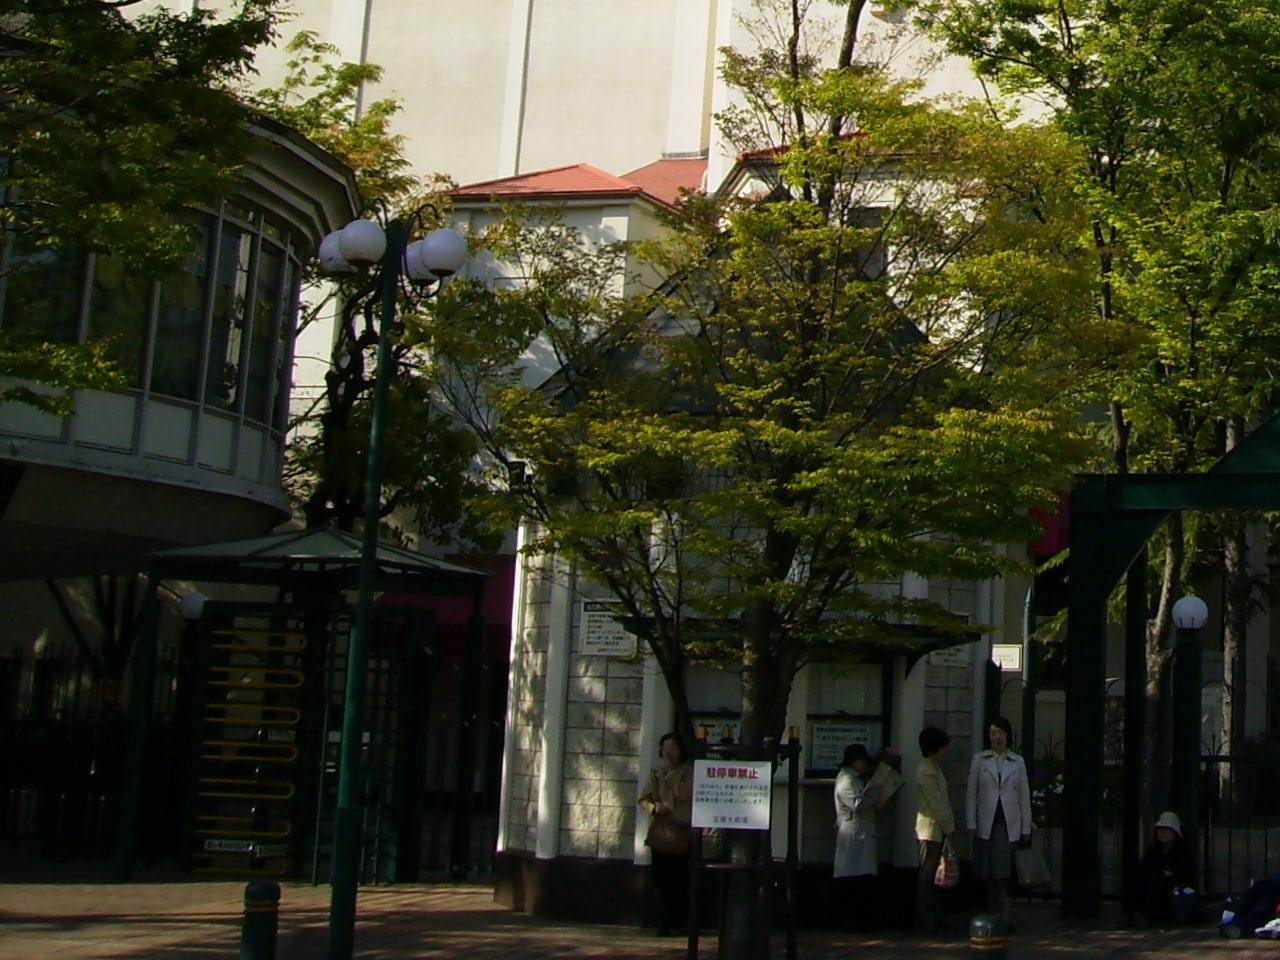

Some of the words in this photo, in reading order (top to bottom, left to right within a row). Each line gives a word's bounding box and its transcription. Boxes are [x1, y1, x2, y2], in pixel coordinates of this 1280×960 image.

[707, 767, 758, 779] 駐停車禁止
